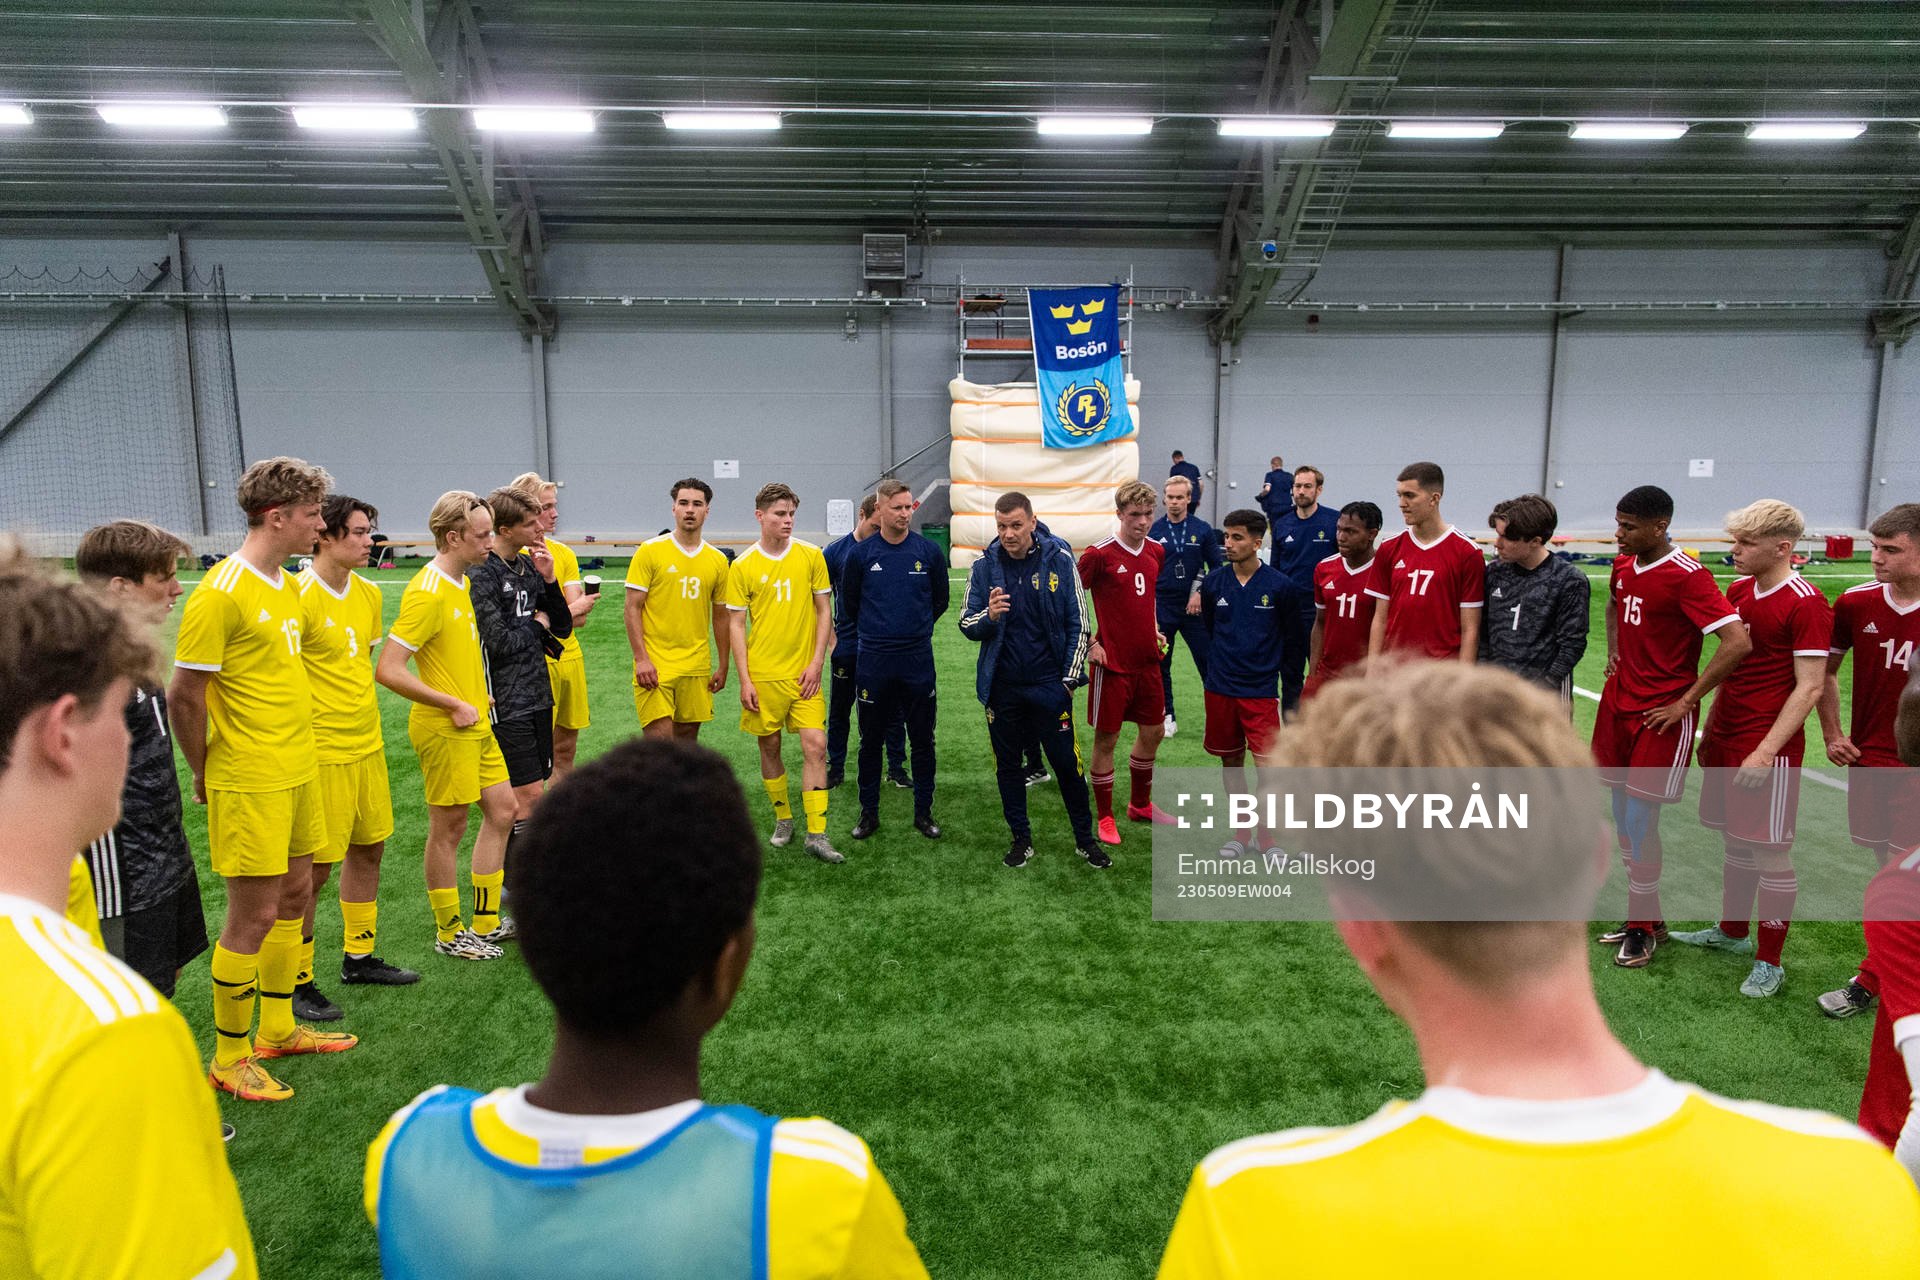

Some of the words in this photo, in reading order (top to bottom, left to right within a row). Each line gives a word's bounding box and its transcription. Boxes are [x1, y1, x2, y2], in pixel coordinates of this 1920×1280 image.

[1055, 341, 1107, 359] Bosön
[679, 575, 701, 599] 13
[773, 577, 791, 602] 11
[1134, 572, 1146, 596] 9
[1407, 569, 1434, 596] 17
[515, 590, 532, 617] 12
[1335, 592, 1358, 619] 11
[1509, 603, 1521, 631] 1
[1622, 594, 1644, 626] 15
[345, 626, 359, 658] 3
[1879, 638, 1914, 672] 14
